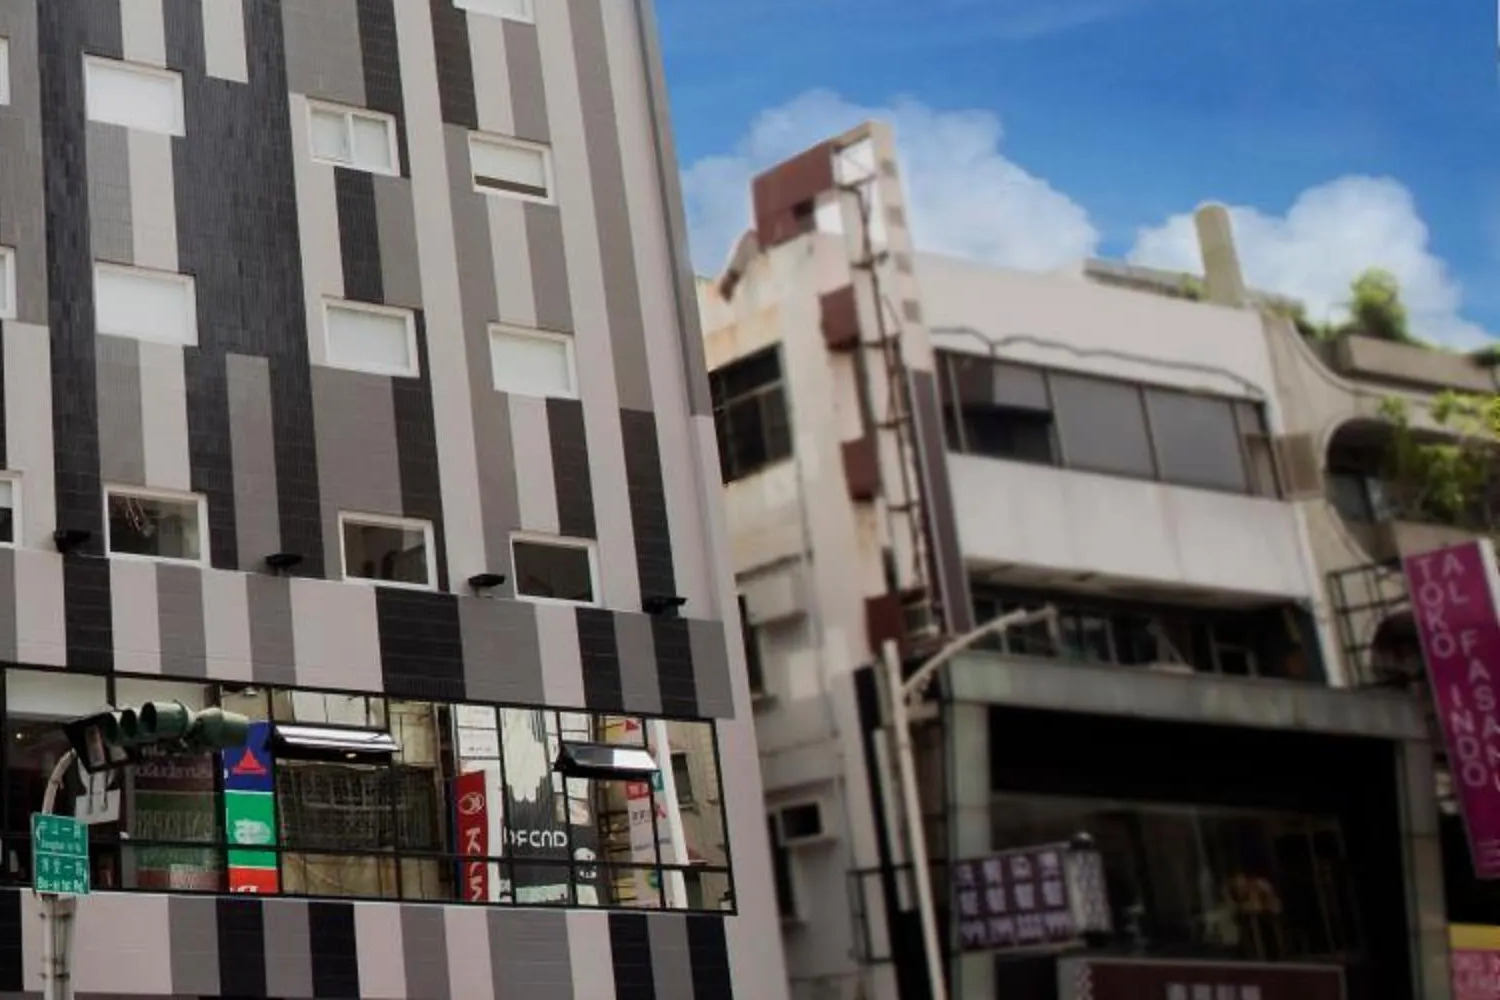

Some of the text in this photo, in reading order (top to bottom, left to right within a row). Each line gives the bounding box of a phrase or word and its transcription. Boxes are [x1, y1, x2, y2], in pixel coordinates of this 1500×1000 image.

[1441, 552, 1470, 606] AL
[1415, 557, 1487, 788] TOKO INDO
